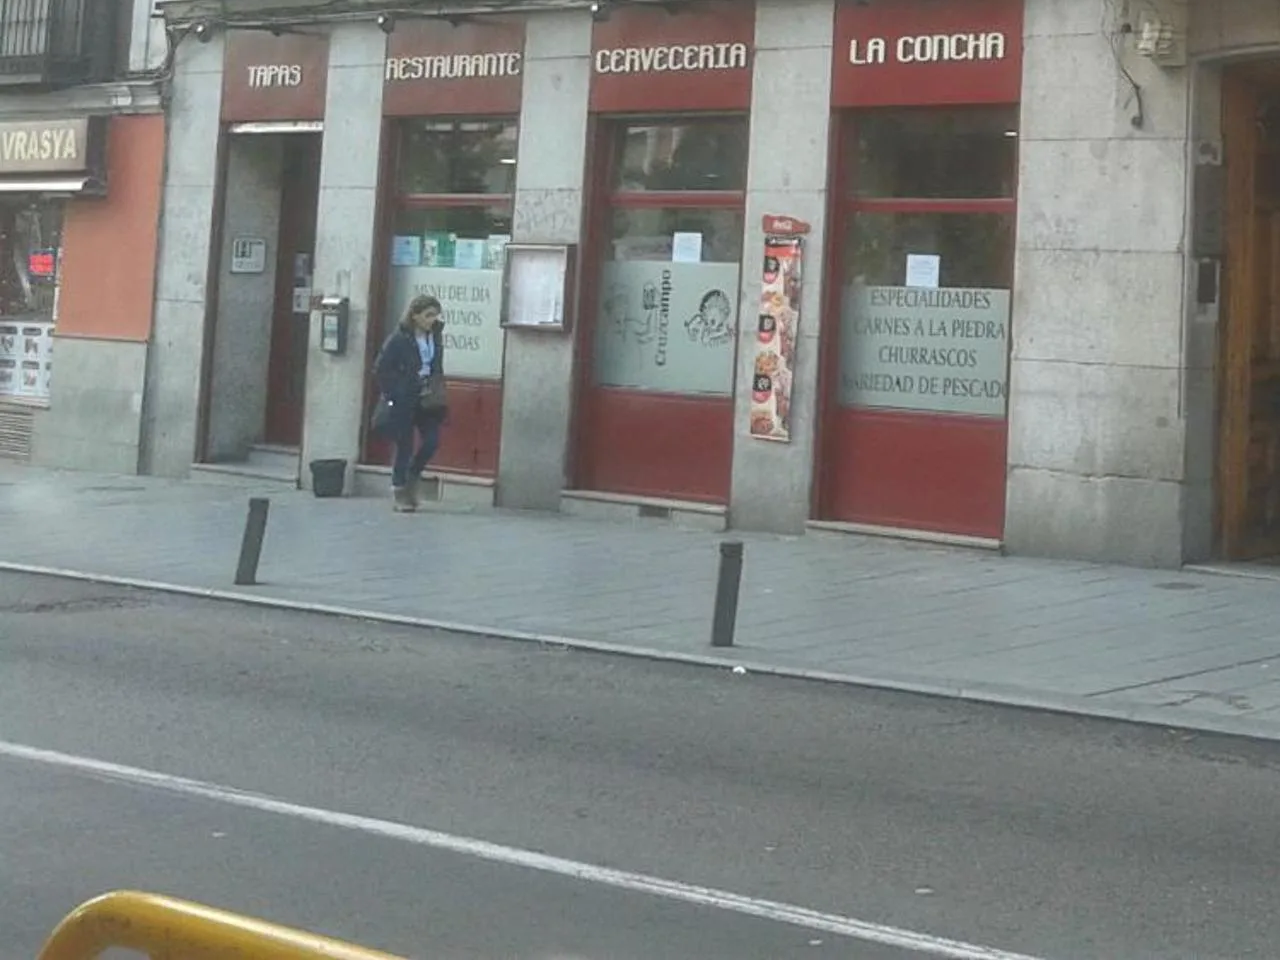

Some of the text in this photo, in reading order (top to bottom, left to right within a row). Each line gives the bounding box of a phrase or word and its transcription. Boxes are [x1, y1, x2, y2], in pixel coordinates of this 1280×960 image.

[595, 43, 747, 74] CERVECERIA
[849, 32, 1005, 64] LA CONCHA
[248, 64, 302, 88] TAPAS
[386, 52, 521, 81] RESTAURANTE
[0, 128, 77, 161] VRASYA
[448, 284, 468, 302] DEL
[871, 290, 992, 310] ESPECIALIDADES
[853, 317, 1005, 340] CARNES A LA PIEDRA
[878, 345, 978, 368] CHURRASCOS
[918, 375, 940, 395] DE
